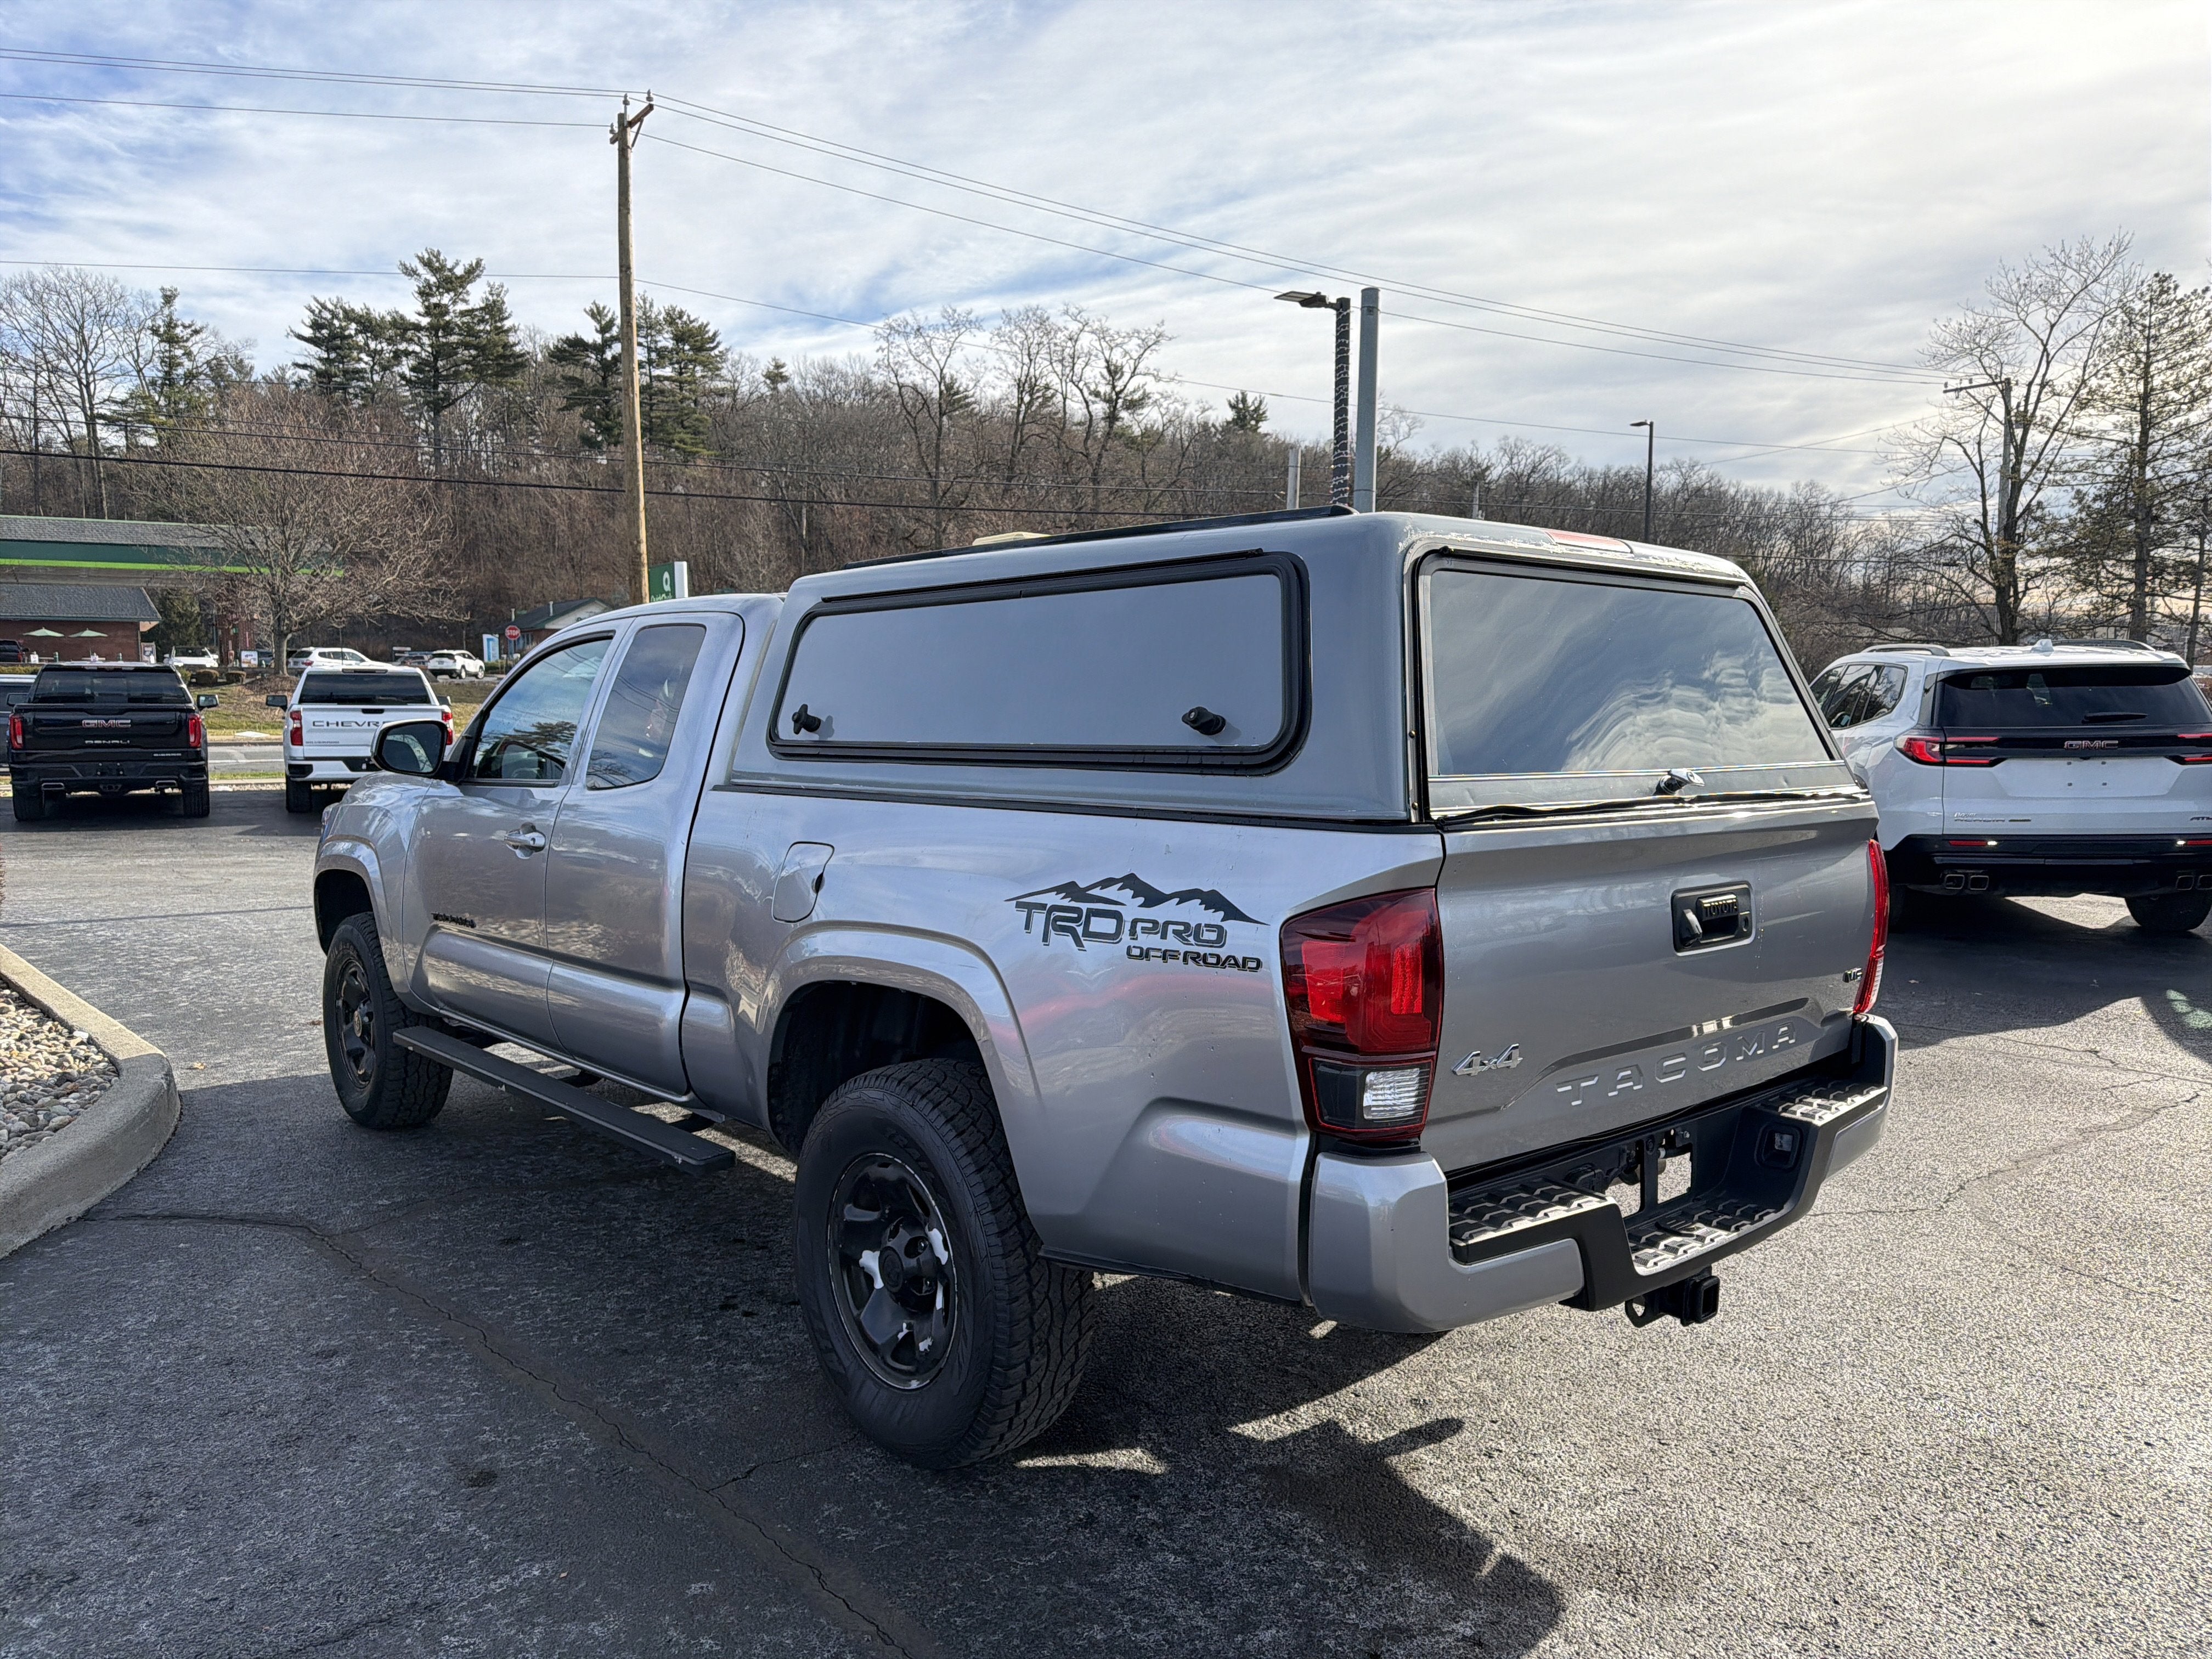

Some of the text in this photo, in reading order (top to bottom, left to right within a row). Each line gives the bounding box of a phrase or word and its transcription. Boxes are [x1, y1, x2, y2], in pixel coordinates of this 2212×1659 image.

[663, 571, 671, 592] Q
[82, 719, 131, 728] GMC
[2063, 740, 2119, 750] GMC
[1702, 899, 1737, 918] TOYOTA
[1015, 900, 1227, 951] TRD PRO
[1555, 1022, 1796, 1106] TACOMA
